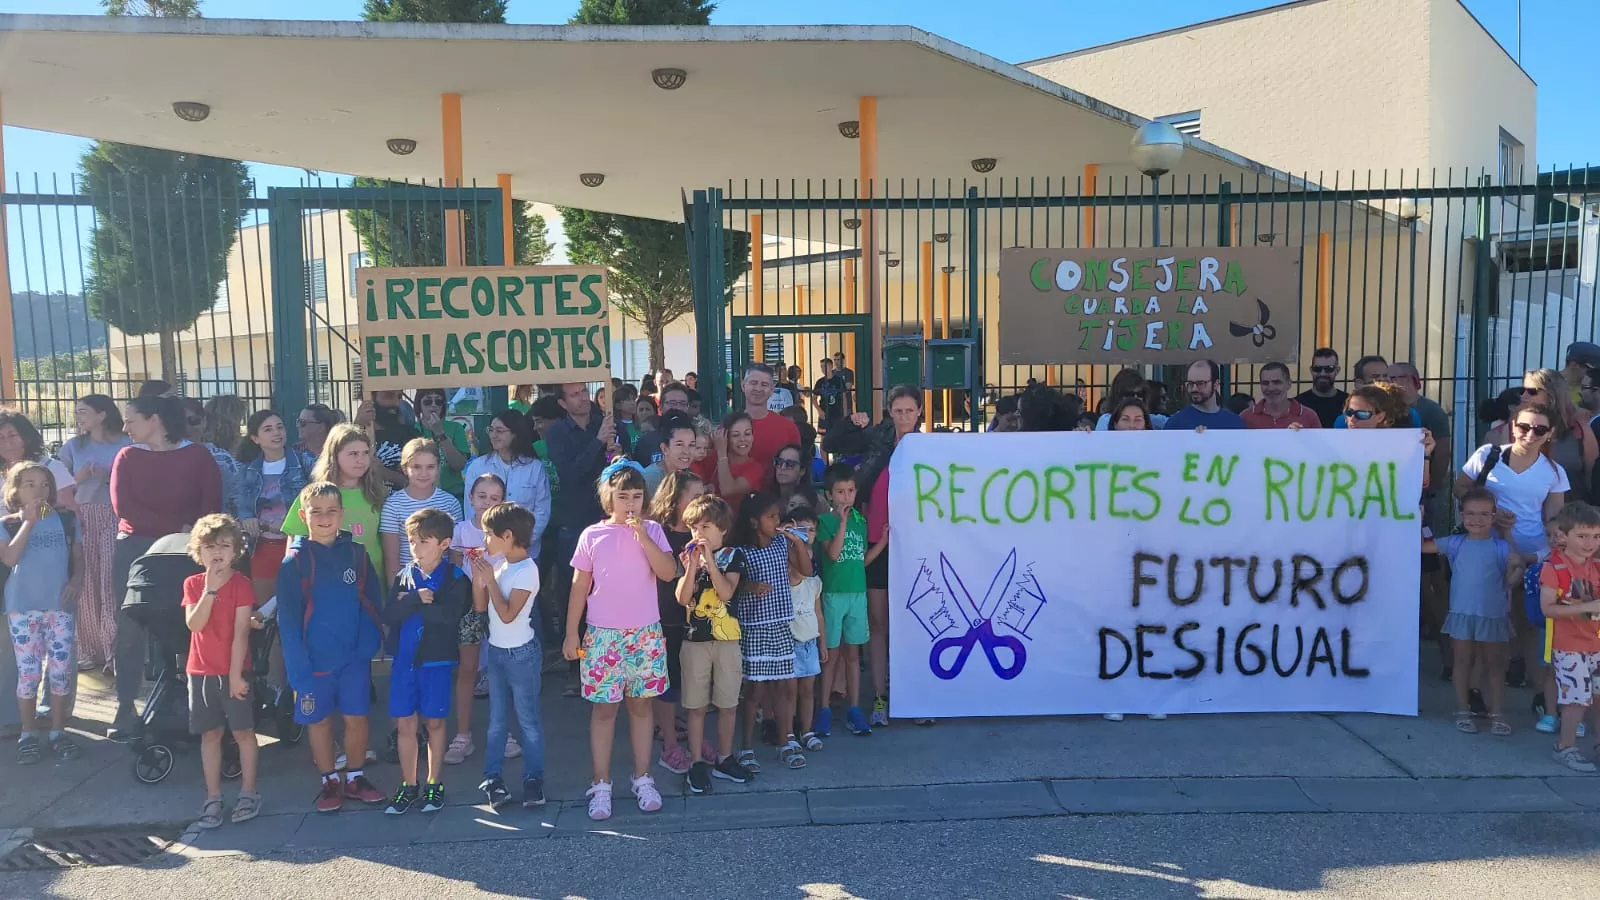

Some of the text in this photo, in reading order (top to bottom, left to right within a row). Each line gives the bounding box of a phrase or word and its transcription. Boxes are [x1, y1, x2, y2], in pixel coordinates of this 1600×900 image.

[1029, 256, 1247, 297] CONSEJERA
[1064, 293, 1209, 315] GUARDA LA
[913, 452, 1416, 524] RECORTES EN RURAL
[1178, 497, 1232, 526] LO
[1131, 552, 1370, 609] FUTURO
[1098, 624, 1371, 681] DESIGUAL
